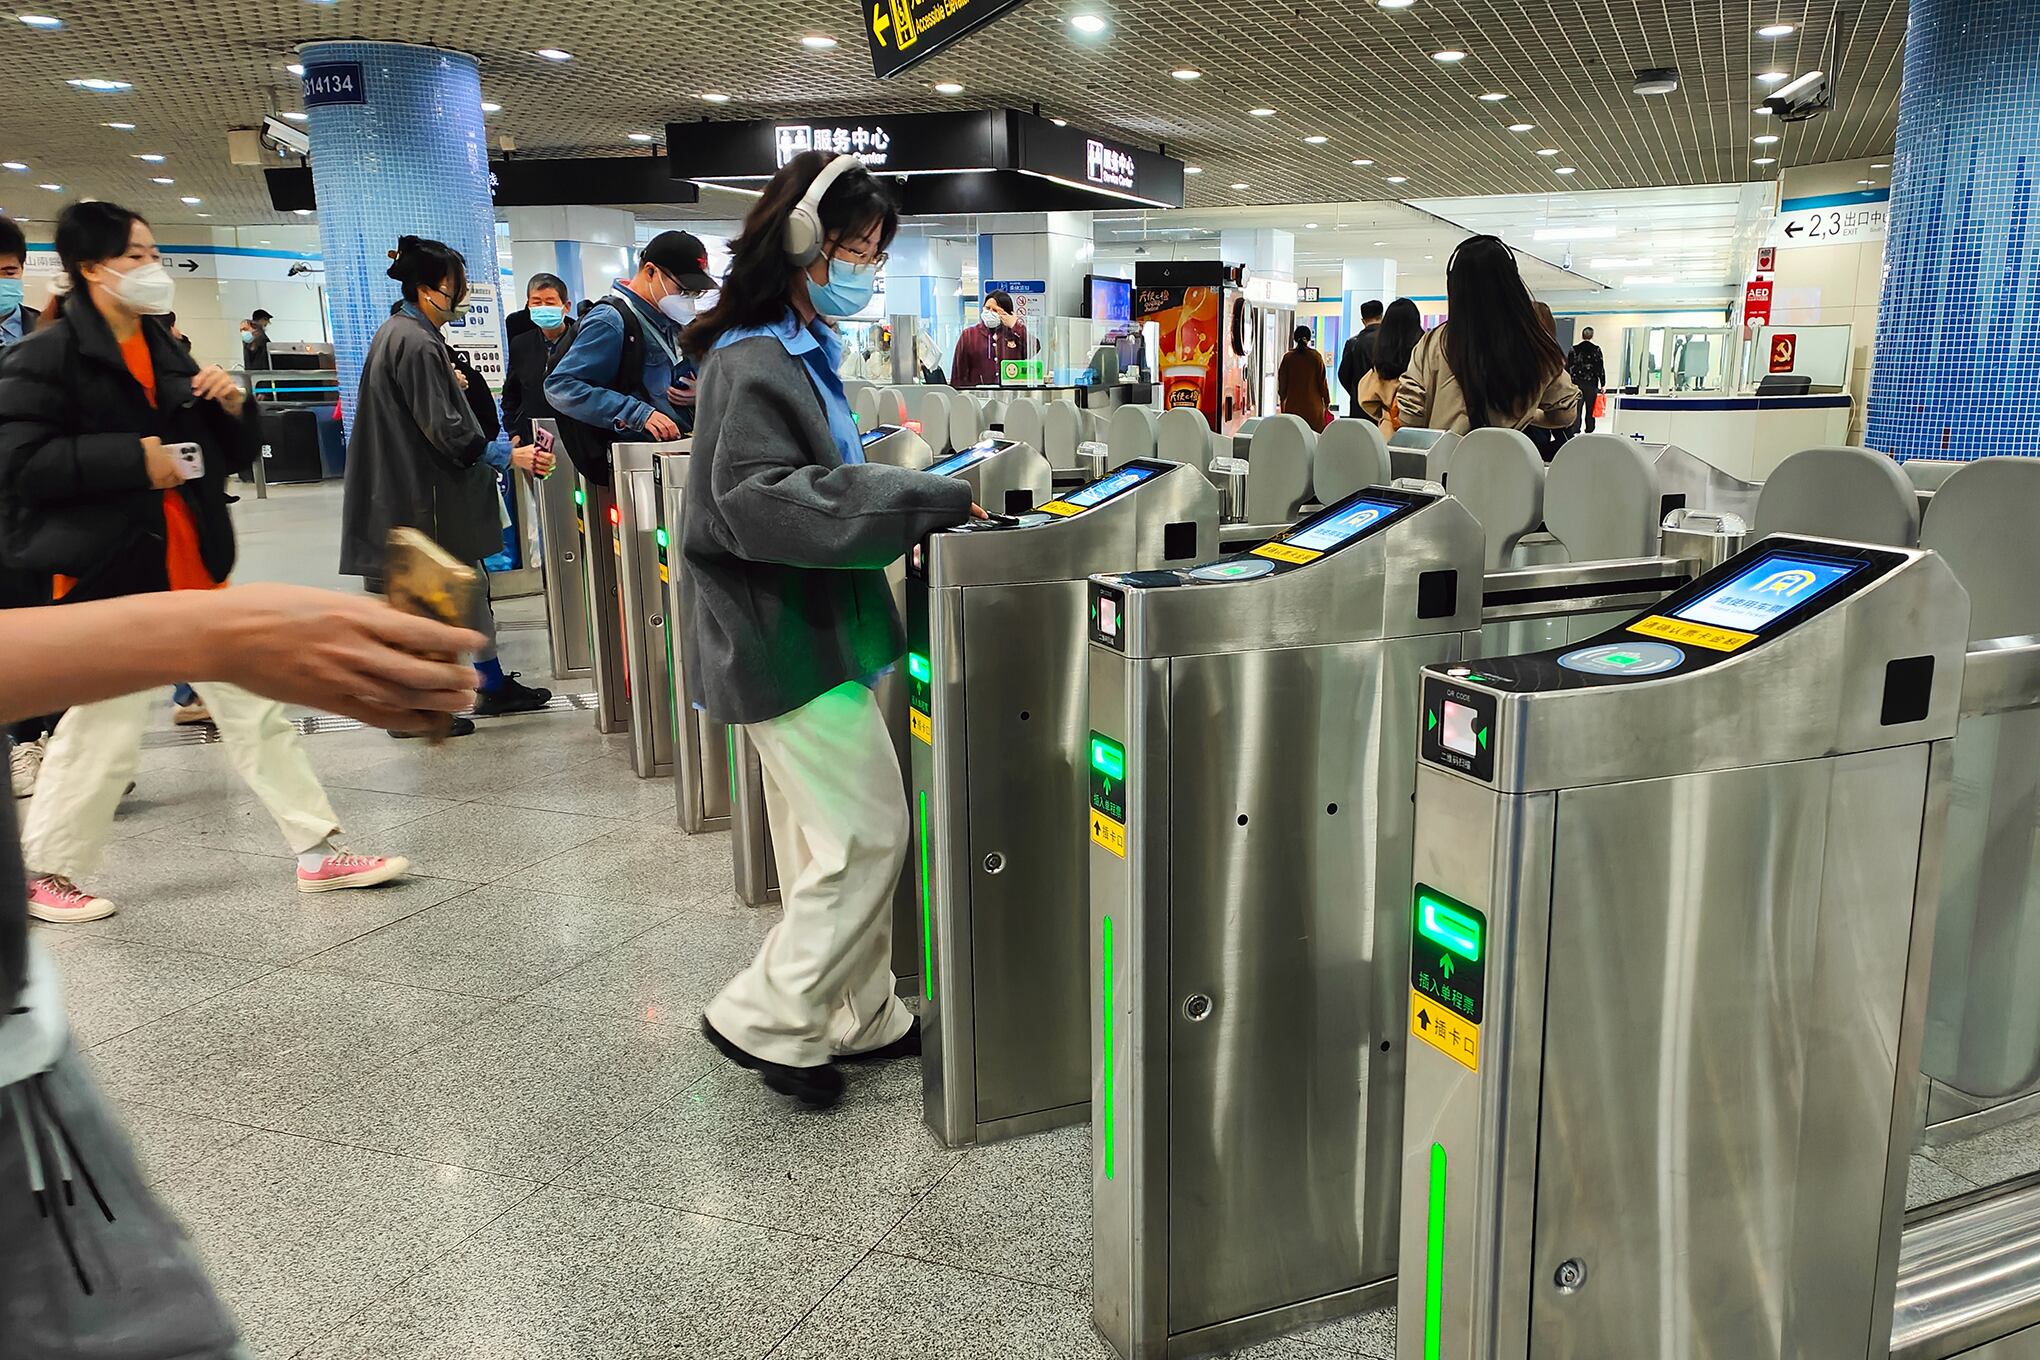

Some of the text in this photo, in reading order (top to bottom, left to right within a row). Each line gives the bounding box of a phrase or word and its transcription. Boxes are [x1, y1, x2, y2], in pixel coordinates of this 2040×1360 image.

[915, 0, 970, 35] Accessible Eleva
[813, 126, 890, 152] 服务中心
[1808, 212, 1842, 240] 2,3
[1842, 227, 1858, 236] EXIT
[1748, 288, 1769, 298] AED
[1447, 689, 1471, 702] QR CODE
[1418, 971, 1475, 1016] 插入单程票
[1434, 1017, 1475, 1056] 插卡口
